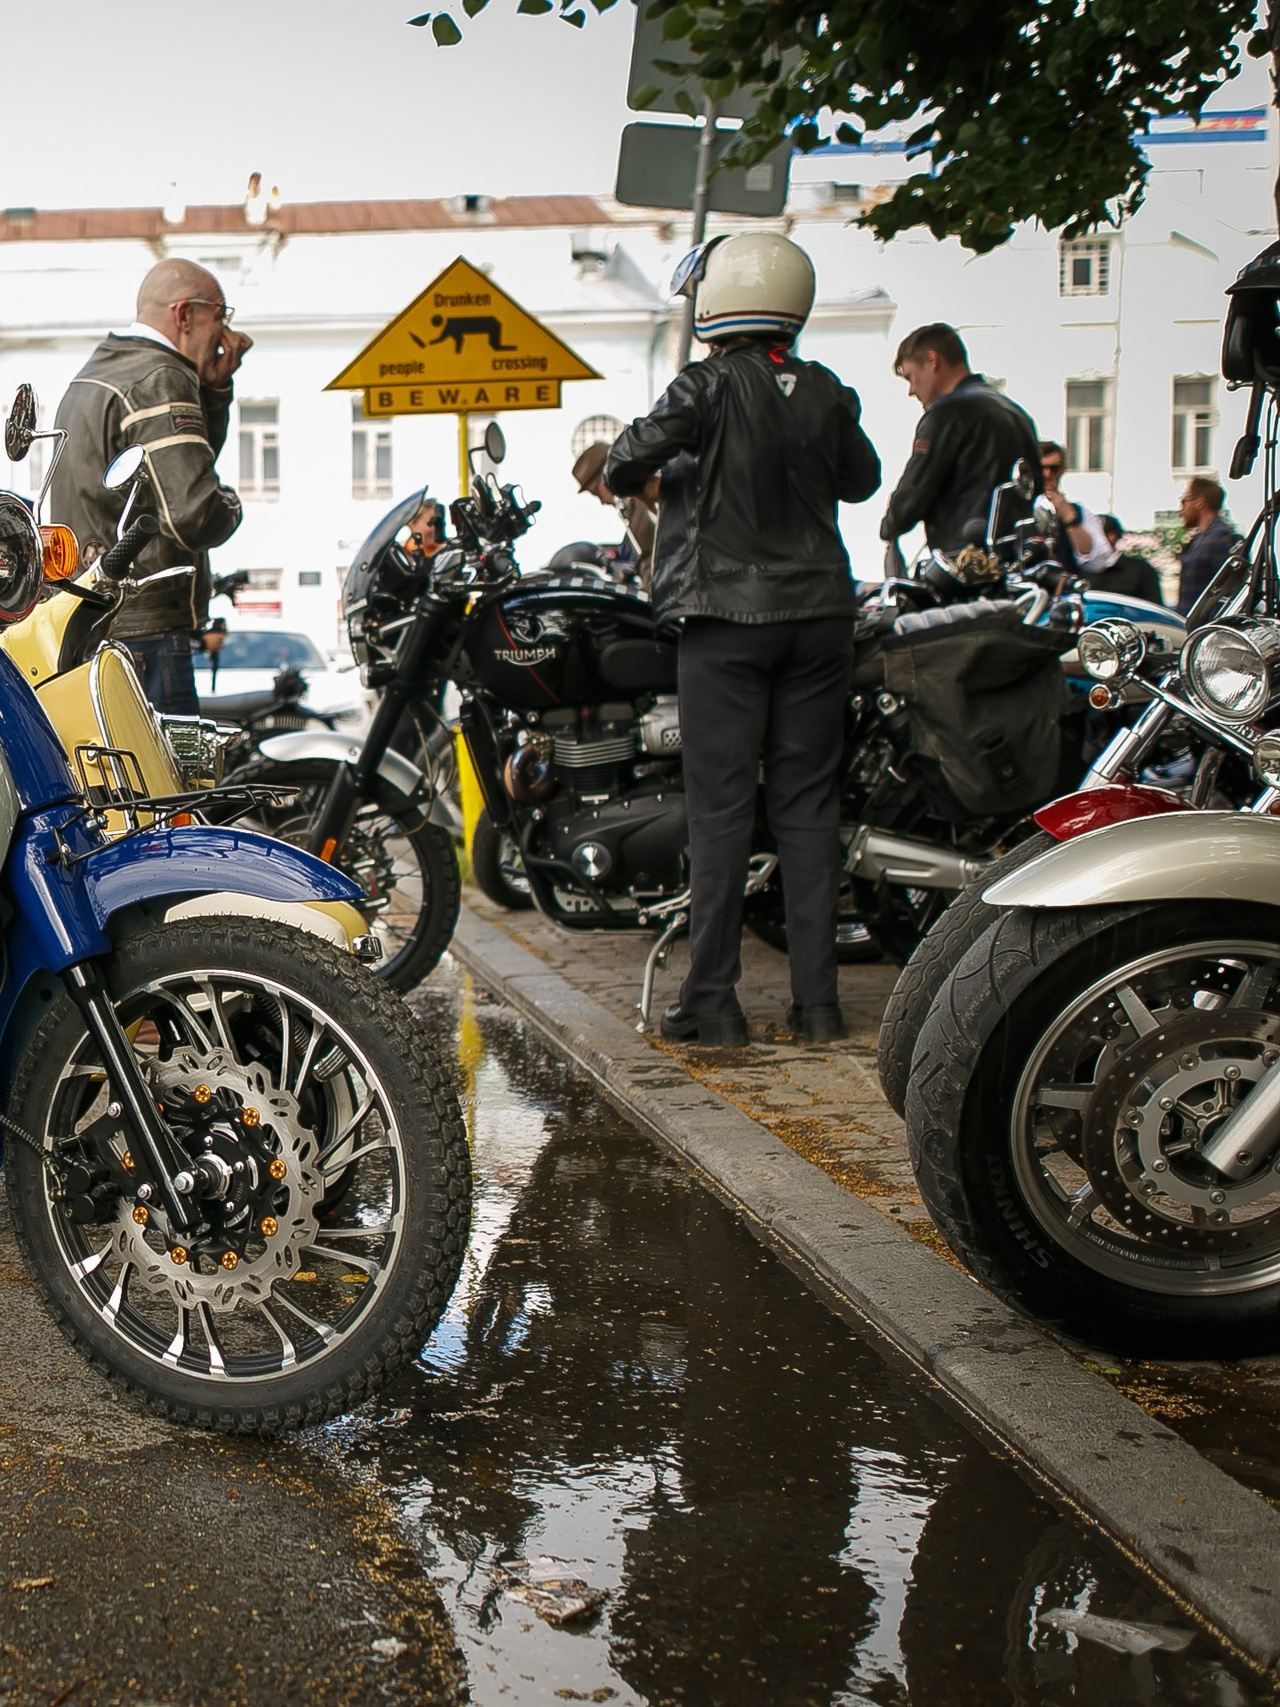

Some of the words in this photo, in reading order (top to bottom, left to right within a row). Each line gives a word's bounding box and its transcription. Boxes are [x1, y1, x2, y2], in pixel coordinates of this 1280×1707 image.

[434, 292, 492, 308] Drunken
[379, 359, 425, 378] people
[492, 354, 548, 372] crossing
[378, 385, 551, 409] BEWARE
[493, 647, 556, 662] TRIUMPH
[985, 1154, 1056, 1268] SHINKO
